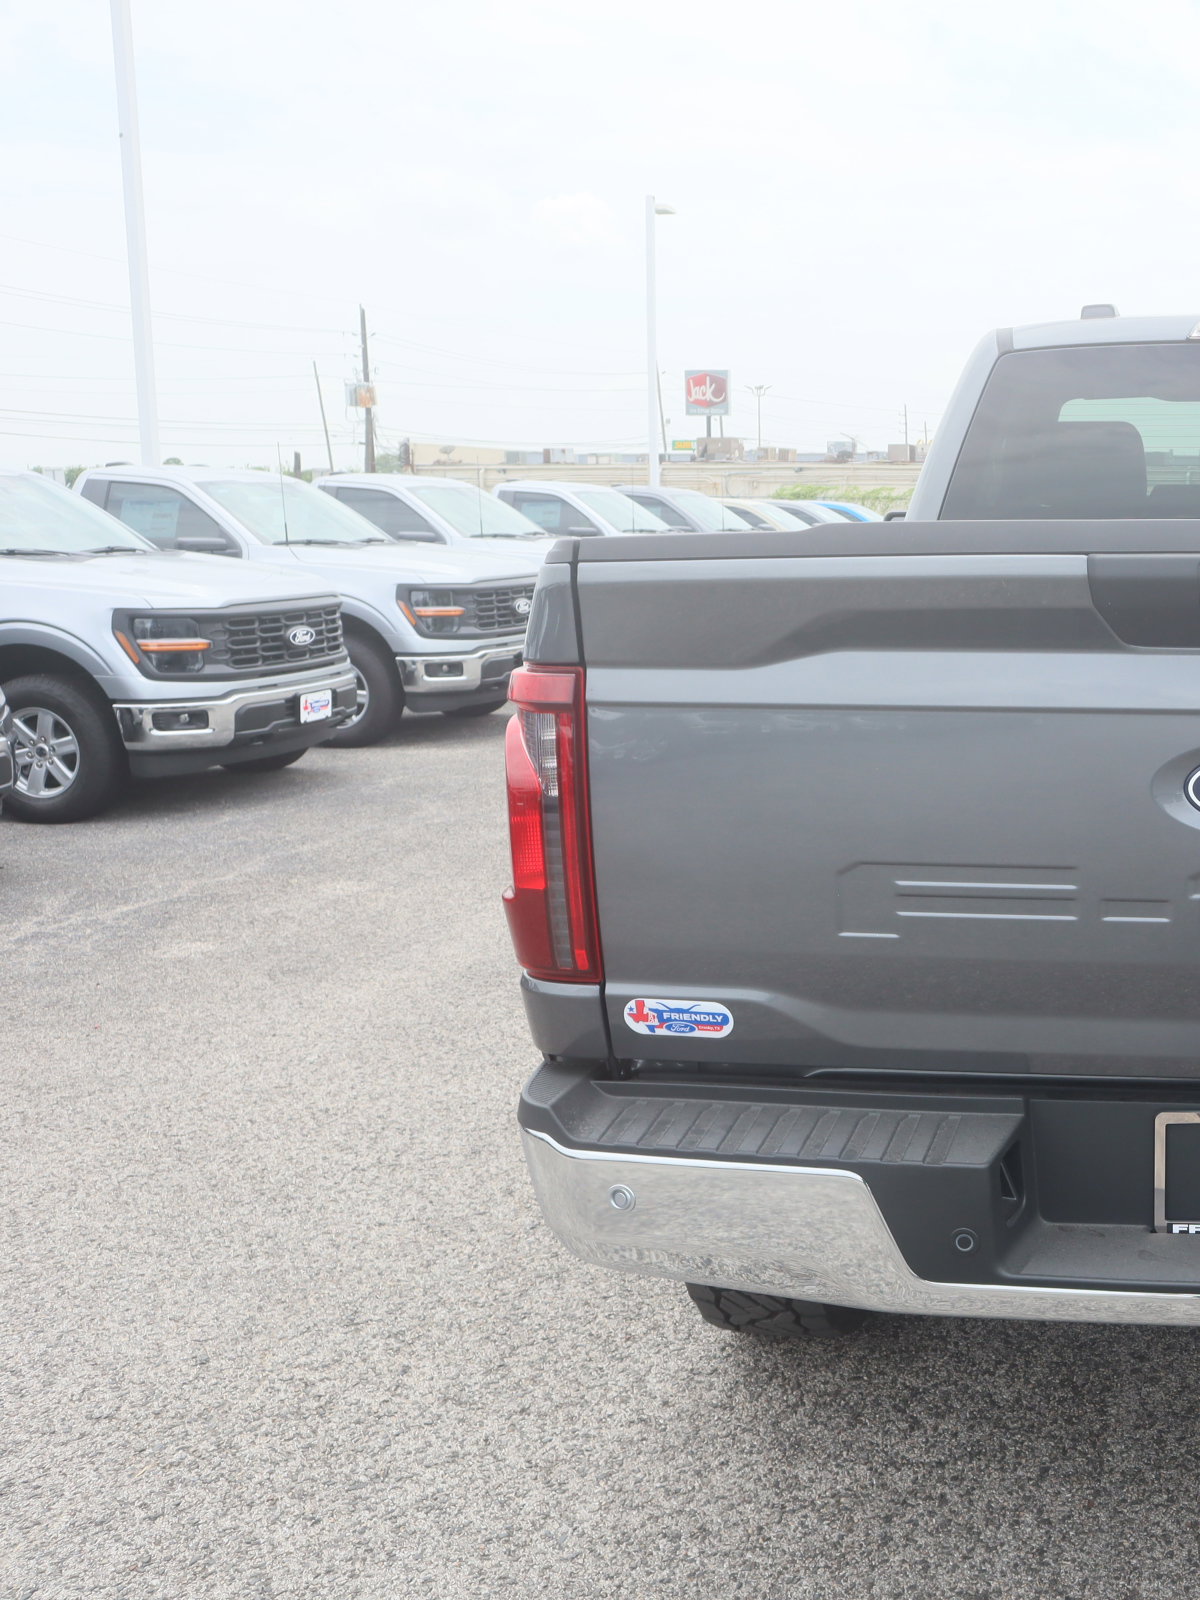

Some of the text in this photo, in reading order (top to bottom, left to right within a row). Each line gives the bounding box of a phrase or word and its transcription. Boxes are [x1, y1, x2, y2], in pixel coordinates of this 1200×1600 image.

[687, 375, 726, 402] Jack
[662, 1012, 724, 1023] FRIENDLY
[670, 1023, 691, 1032] Ford
